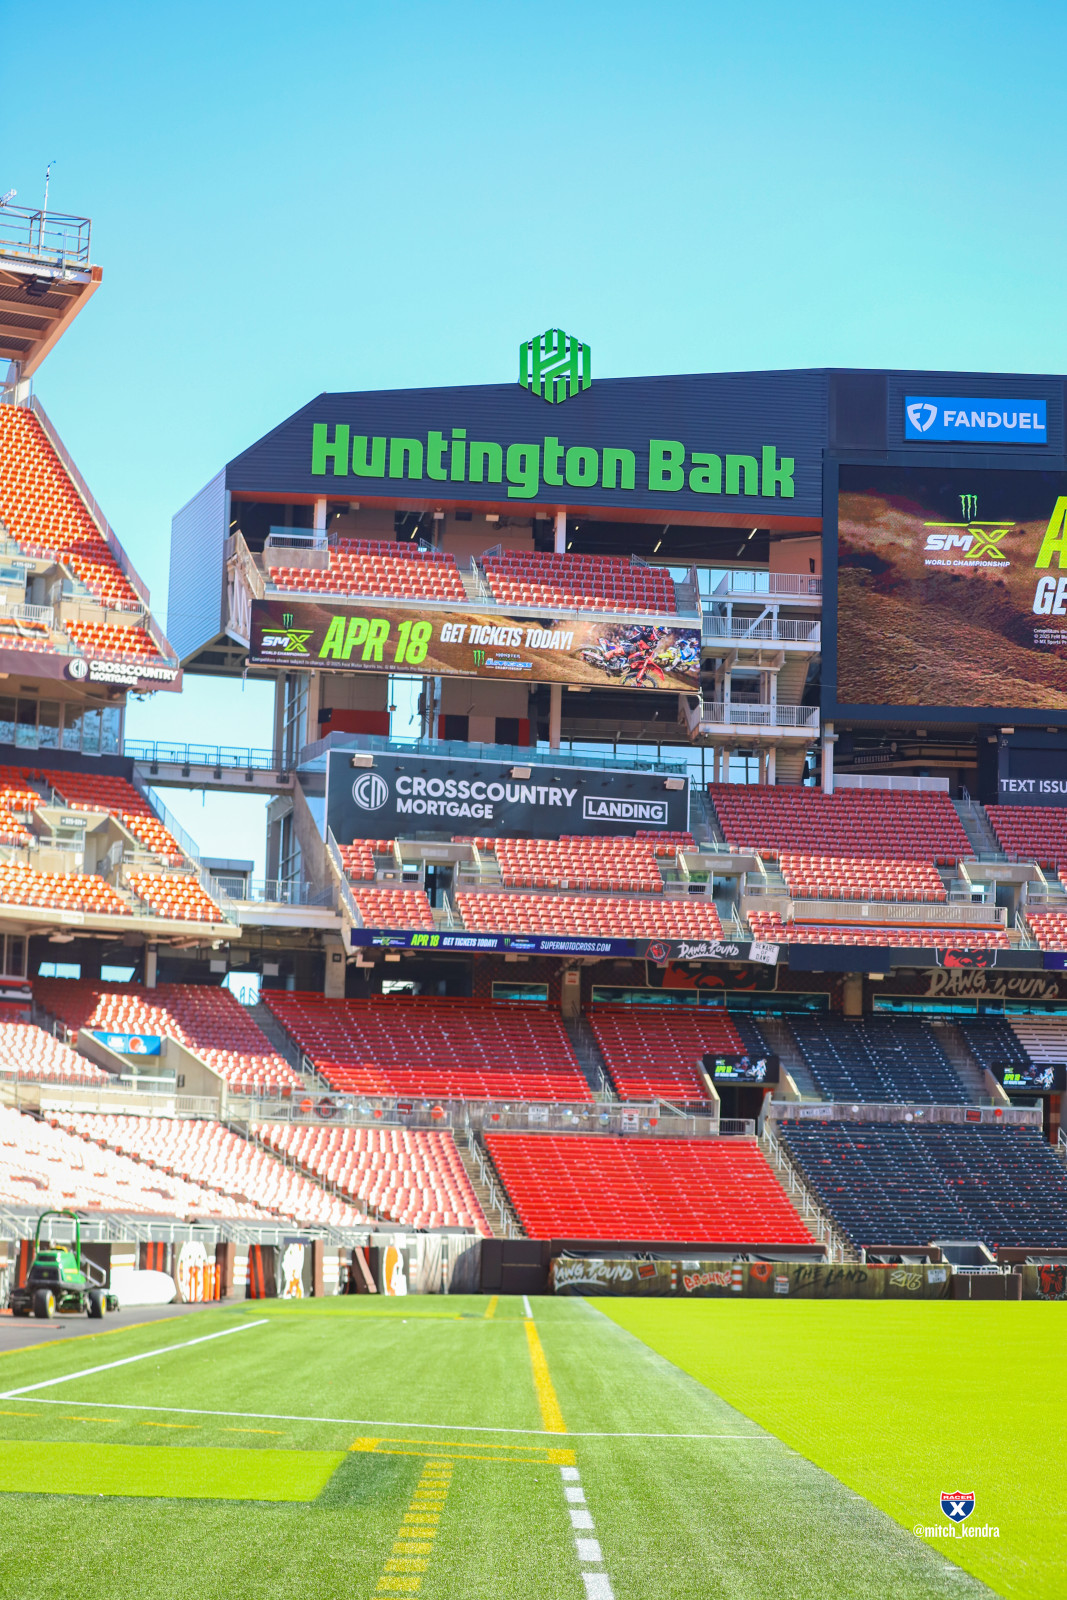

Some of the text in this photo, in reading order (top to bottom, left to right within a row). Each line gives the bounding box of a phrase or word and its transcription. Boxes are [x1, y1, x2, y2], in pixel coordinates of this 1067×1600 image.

[943, 410, 1045, 429] FANDUEL
[311, 423, 795, 498] Huntington Bank
[924, 529, 1010, 559] SMX
[952, 560, 1011, 568] CHAMPIONSHIP
[1032, 576, 1067, 615] GE
[261, 633, 311, 653] SMX
[318, 616, 433, 665] APR 18
[439, 622, 574, 651] GET TICKETS TODAY!
[89, 659, 179, 681] CROSSCOUNTRY
[89, 670, 139, 686] MORTGAGE
[395, 775, 578, 807] CROSSCOUNTRY
[1000, 778, 1036, 792] TEXT
[396, 797, 494, 819] MORTGAGE
[587, 800, 664, 820] LANDING
[410, 933, 430, 947] APR
[430, 934, 440, 948] 18
[442, 936, 498, 948] GET TICKETS TODAY!
[540, 940, 611, 952] SUPERMOTOCROSS.COM
